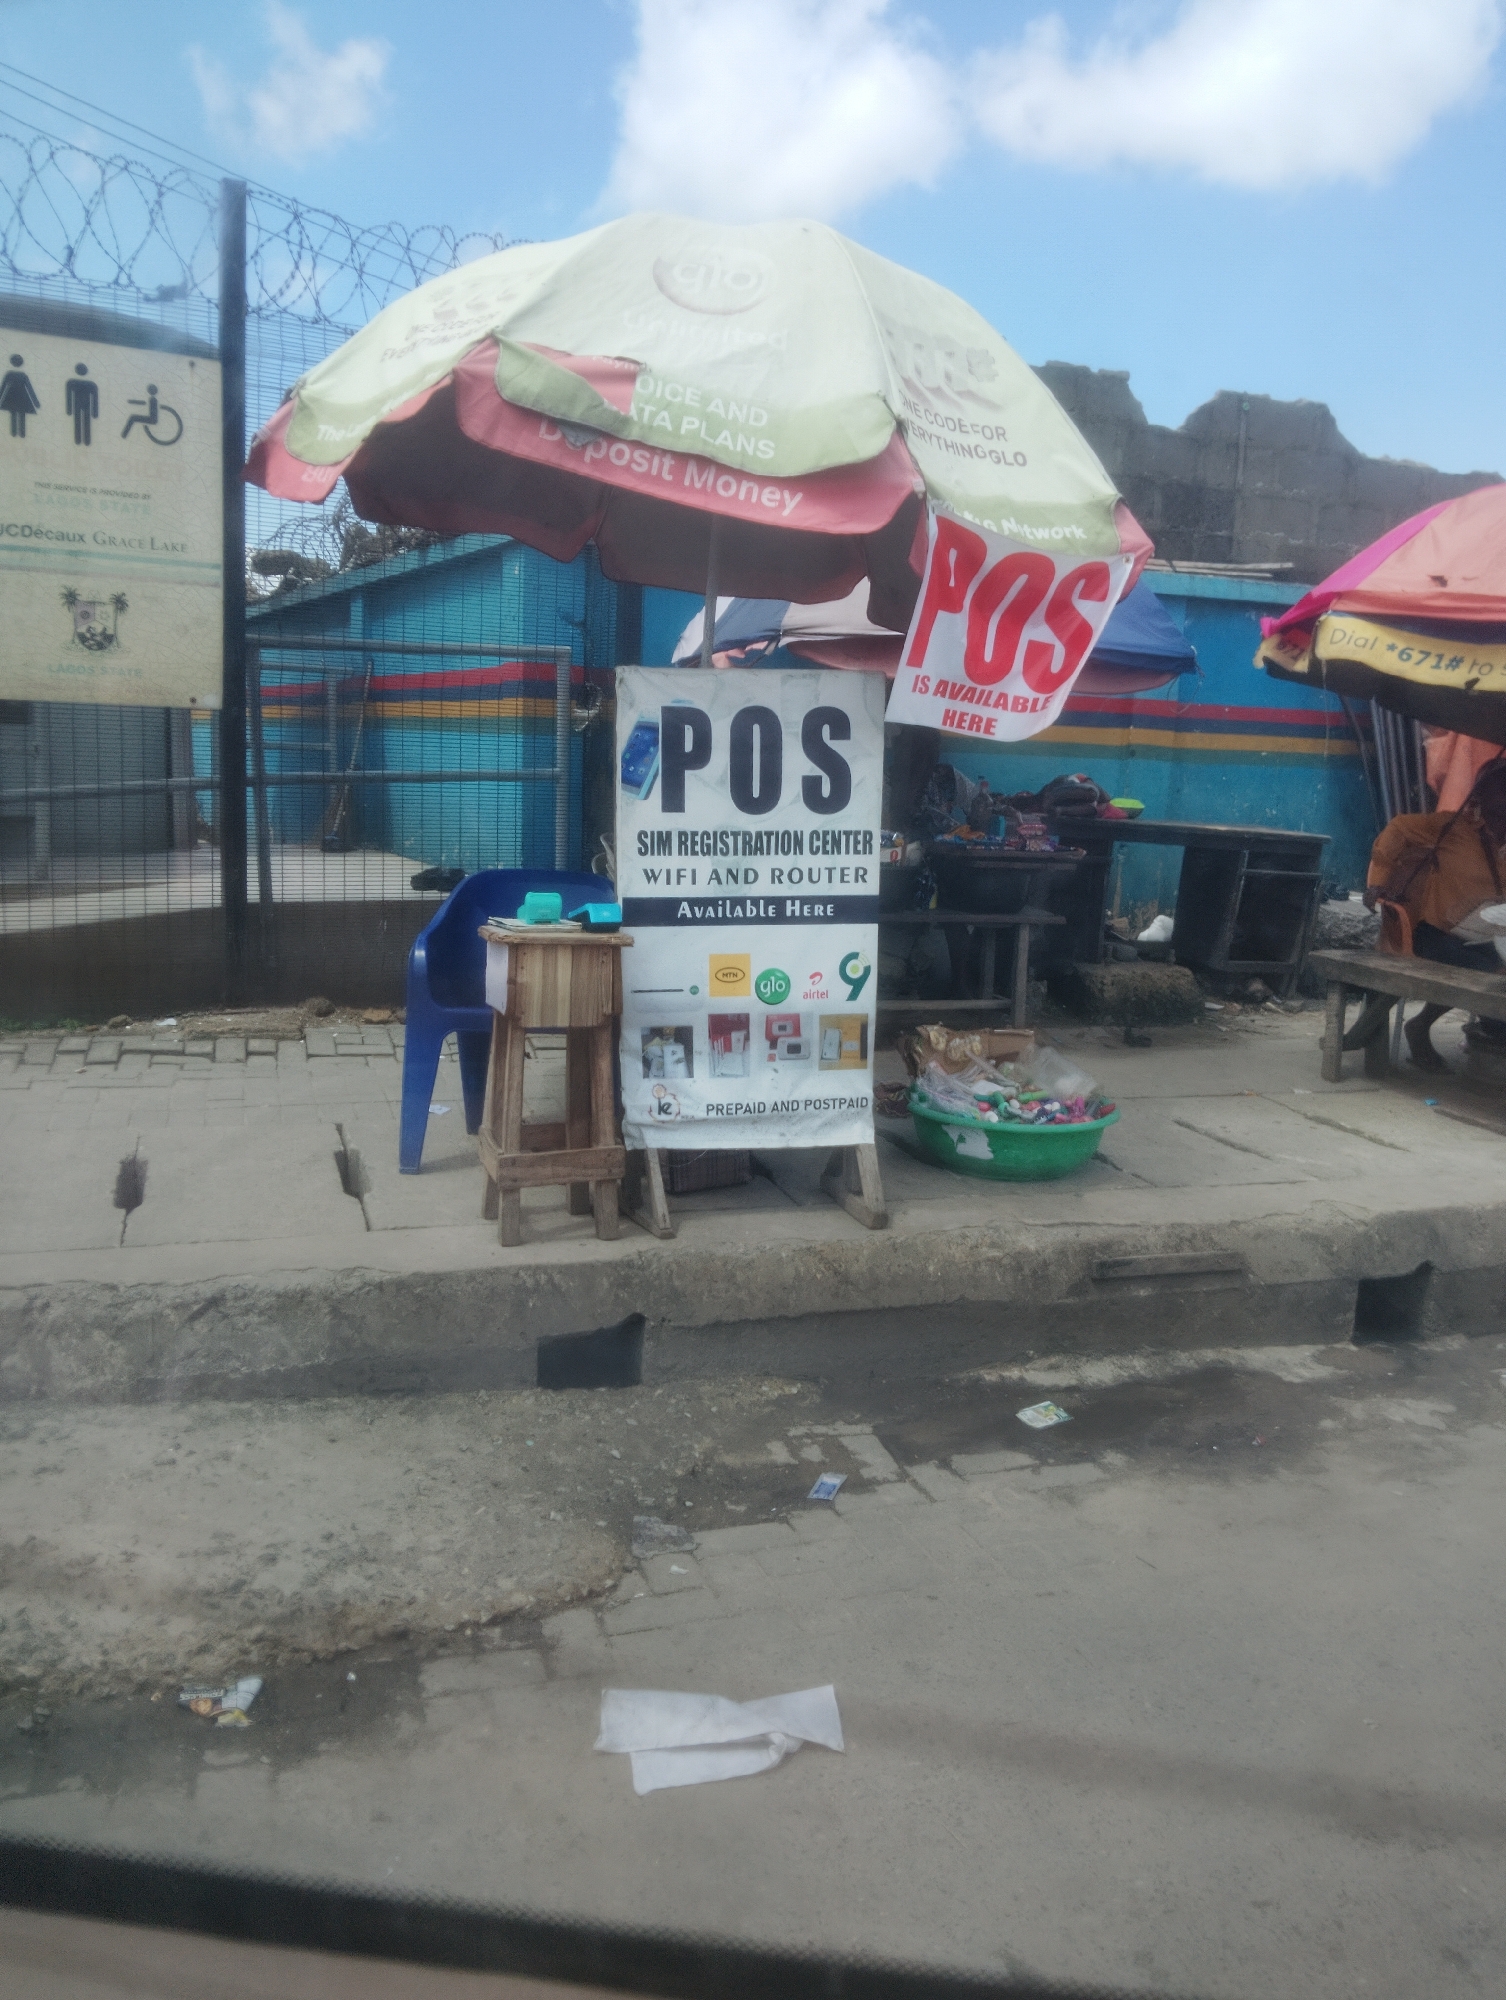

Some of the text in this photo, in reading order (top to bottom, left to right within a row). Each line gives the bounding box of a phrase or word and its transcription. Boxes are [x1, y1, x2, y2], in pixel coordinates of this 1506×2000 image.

[635, 374, 769, 428] OICE AND
[628, 401, 777, 460] ATA PLANS
[924, 408, 970, 435] CODE
[970, 422, 1009, 443] FOR
[538, 419, 804, 518] Dposit Money
[988, 450, 1028, 468] GLO
[53, 483, 88, 494] SERVICE
[98, 488, 140, 500] PROVIDED
[1000, 516, 1088, 540] Ntwork
[906, 515, 1110, 695] POS
[1329, 628, 1379, 651] Dial
[1467, 659, 1494, 676] to
[47, 662, 144, 679] LAGOS STATE
[911, 674, 1053, 713] IS AVAILABLE
[941, 708, 999, 736] HERE
[660, 705, 852, 815] POS
[637, 829, 873, 857] SIM REGISTRATION CENTER
[642, 866, 869, 886] WIFI AND ROUTER
[721, 971, 738, 979] MTN
[760, 975, 786, 998] glo
[802, 989, 829, 1001] airtel
[706, 1096, 868, 1117] PREPAID AND POSTPAID
